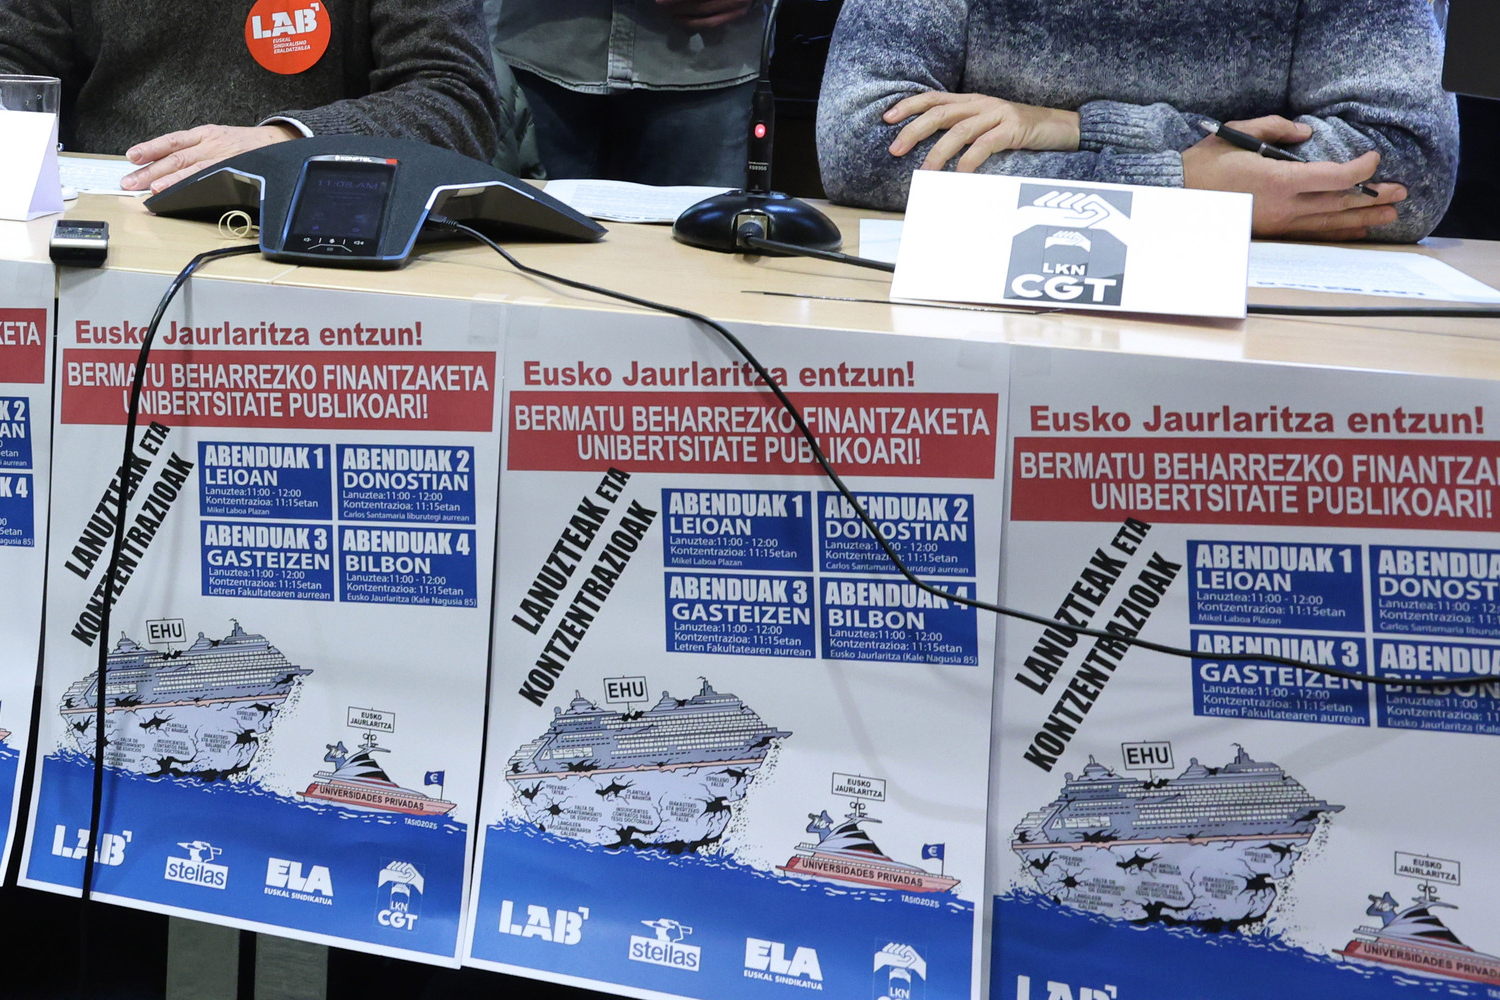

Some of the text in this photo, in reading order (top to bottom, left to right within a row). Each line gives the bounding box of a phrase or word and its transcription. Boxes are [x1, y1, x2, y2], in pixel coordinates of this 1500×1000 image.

[252, 3, 319, 39] LAB
[1042, 263, 1085, 275] LKN
[1011, 274, 1117, 302] CGT
[171, 364, 317, 389] BEHARREZKO
[323, 365, 490, 391] FINANTZAKETA
[523, 361, 915, 387] Eusko Jaurlaritza entzun!
[14, 401, 25, 421] 2
[1030, 406, 1485, 434] Eusko Jaurlaritza entzun!
[16, 477, 28, 498] 4
[23, 538, 34, 546] 85)
